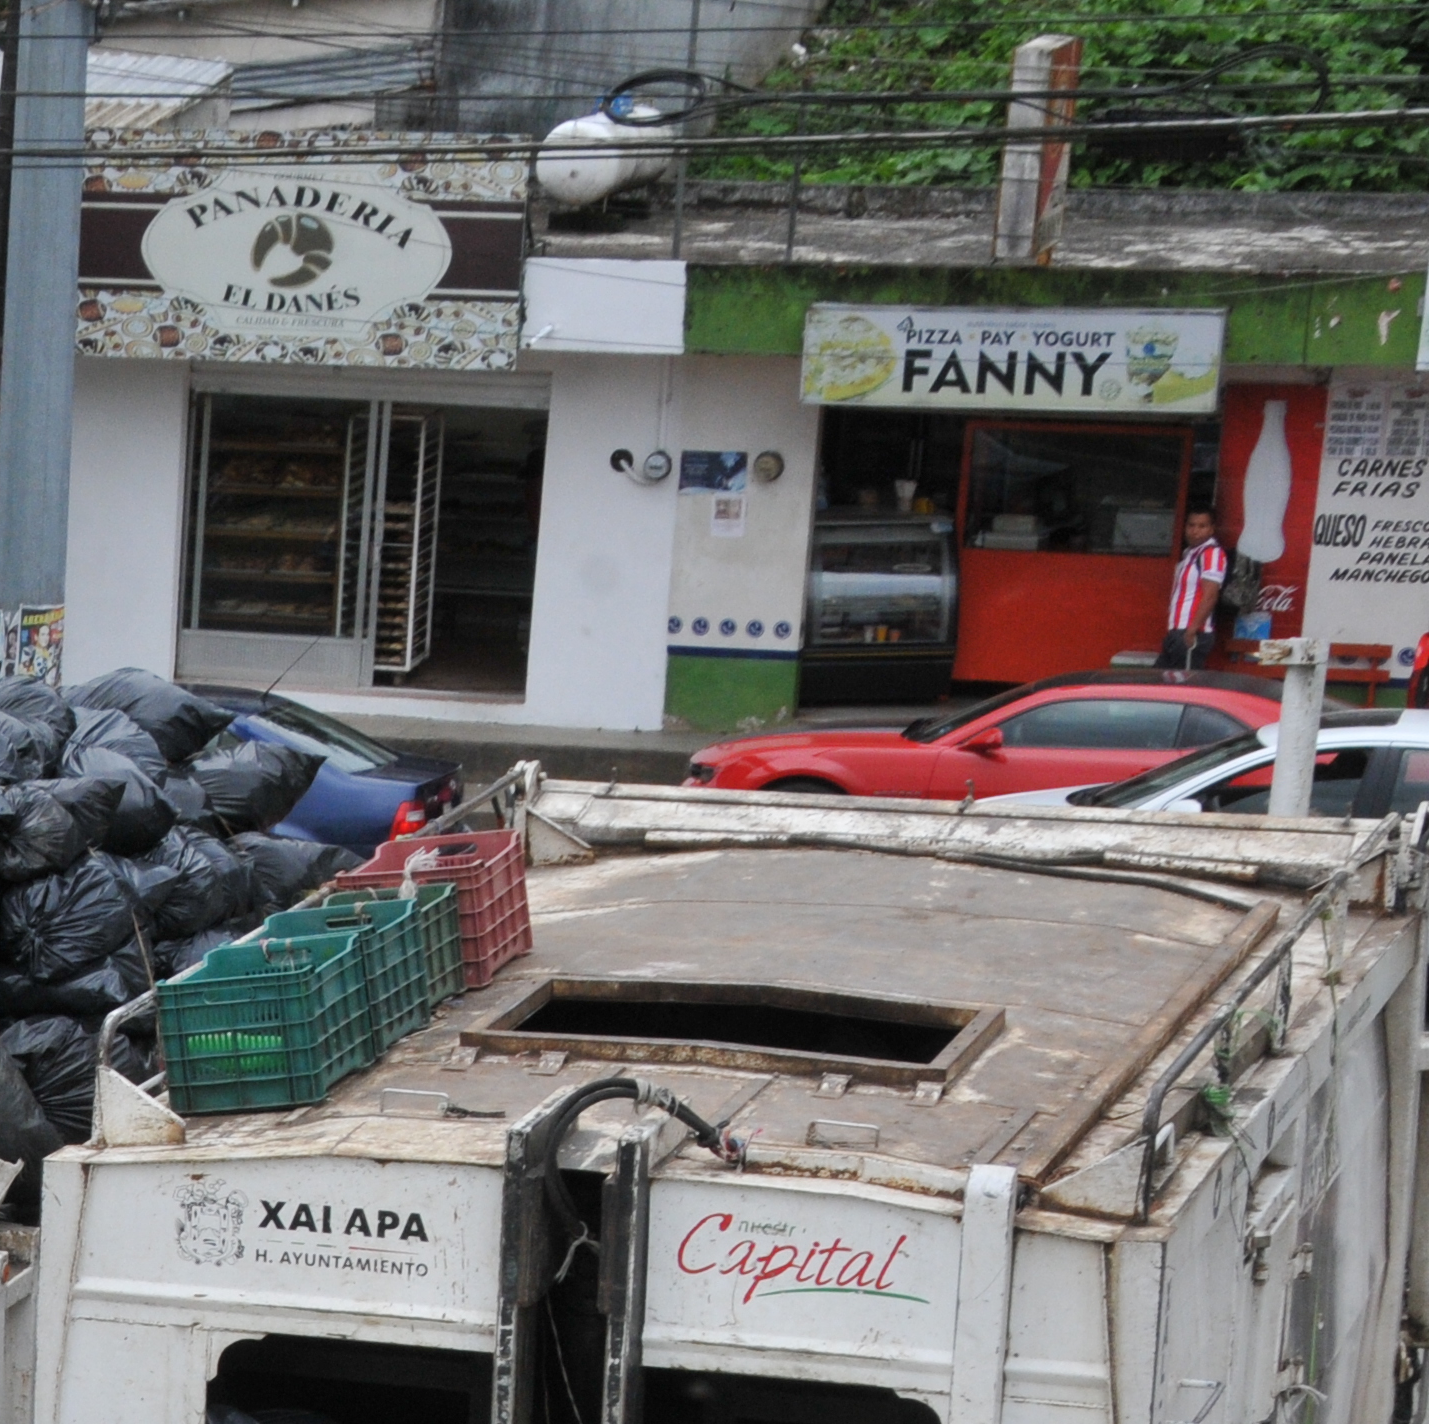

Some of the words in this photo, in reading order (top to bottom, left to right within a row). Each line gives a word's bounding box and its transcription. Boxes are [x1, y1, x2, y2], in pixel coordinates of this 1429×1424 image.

[186, 184, 413, 250] PANADERIA
[222, 284, 257, 308] EL
[265, 284, 361, 313] DANÉS
[236, 316, 279, 327] CALIDAD
[906, 328, 963, 345] PIZZA
[980, 330, 1016, 346] PAY
[1032, 331, 1117, 347] YOGURT
[902, 348, 1113, 397] FANNY
[1337, 458, 1428, 478] CARNES
[1332, 481, 1421, 498] FRIAS
[1313, 513, 1367, 548] QUESO
[255, 1249, 273, 1264] H.
[280, 1251, 429, 1277] AYUNTAMIENTO
[677, 1213, 909, 1304] Capital
